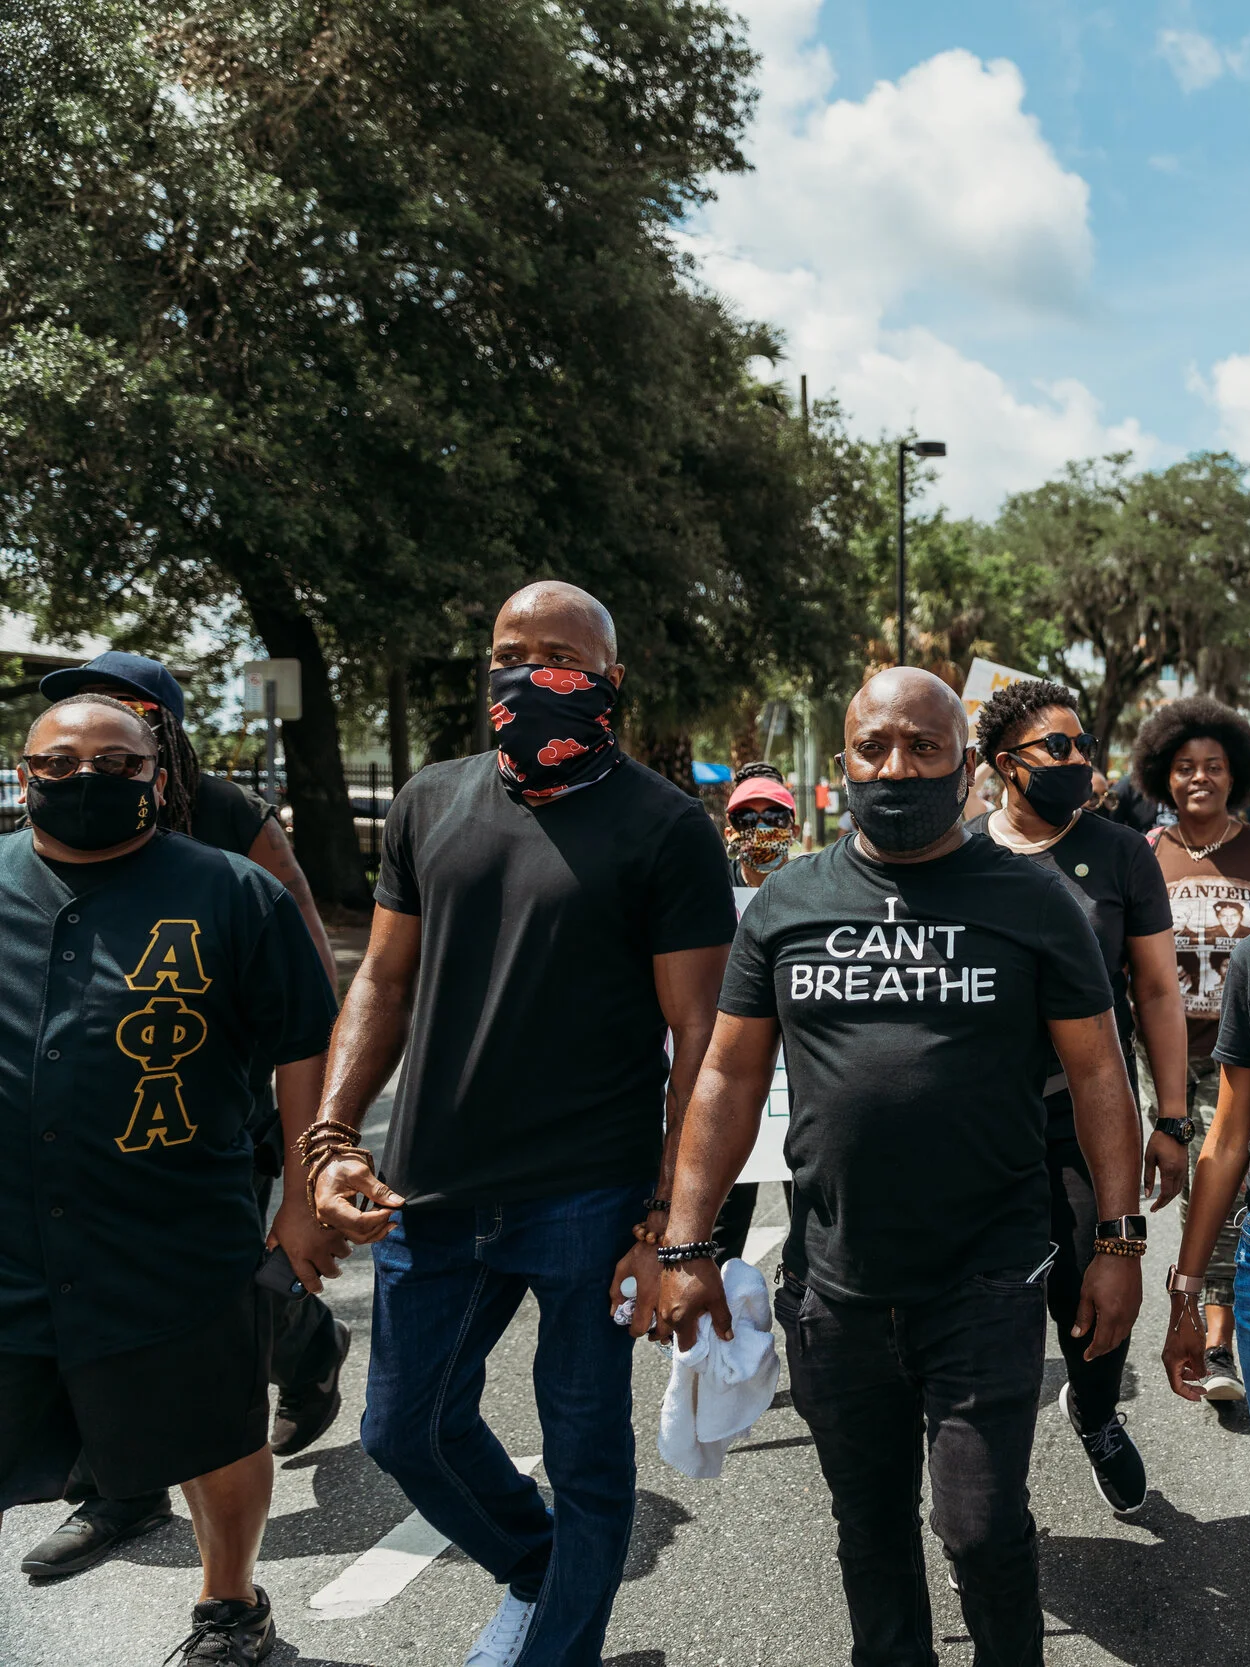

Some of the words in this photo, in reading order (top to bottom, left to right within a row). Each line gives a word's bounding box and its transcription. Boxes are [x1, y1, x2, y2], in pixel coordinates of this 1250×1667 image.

[883, 897, 898, 923] I
[825, 926, 965, 960] CAN'T
[791, 964, 996, 1003] BREATHE
